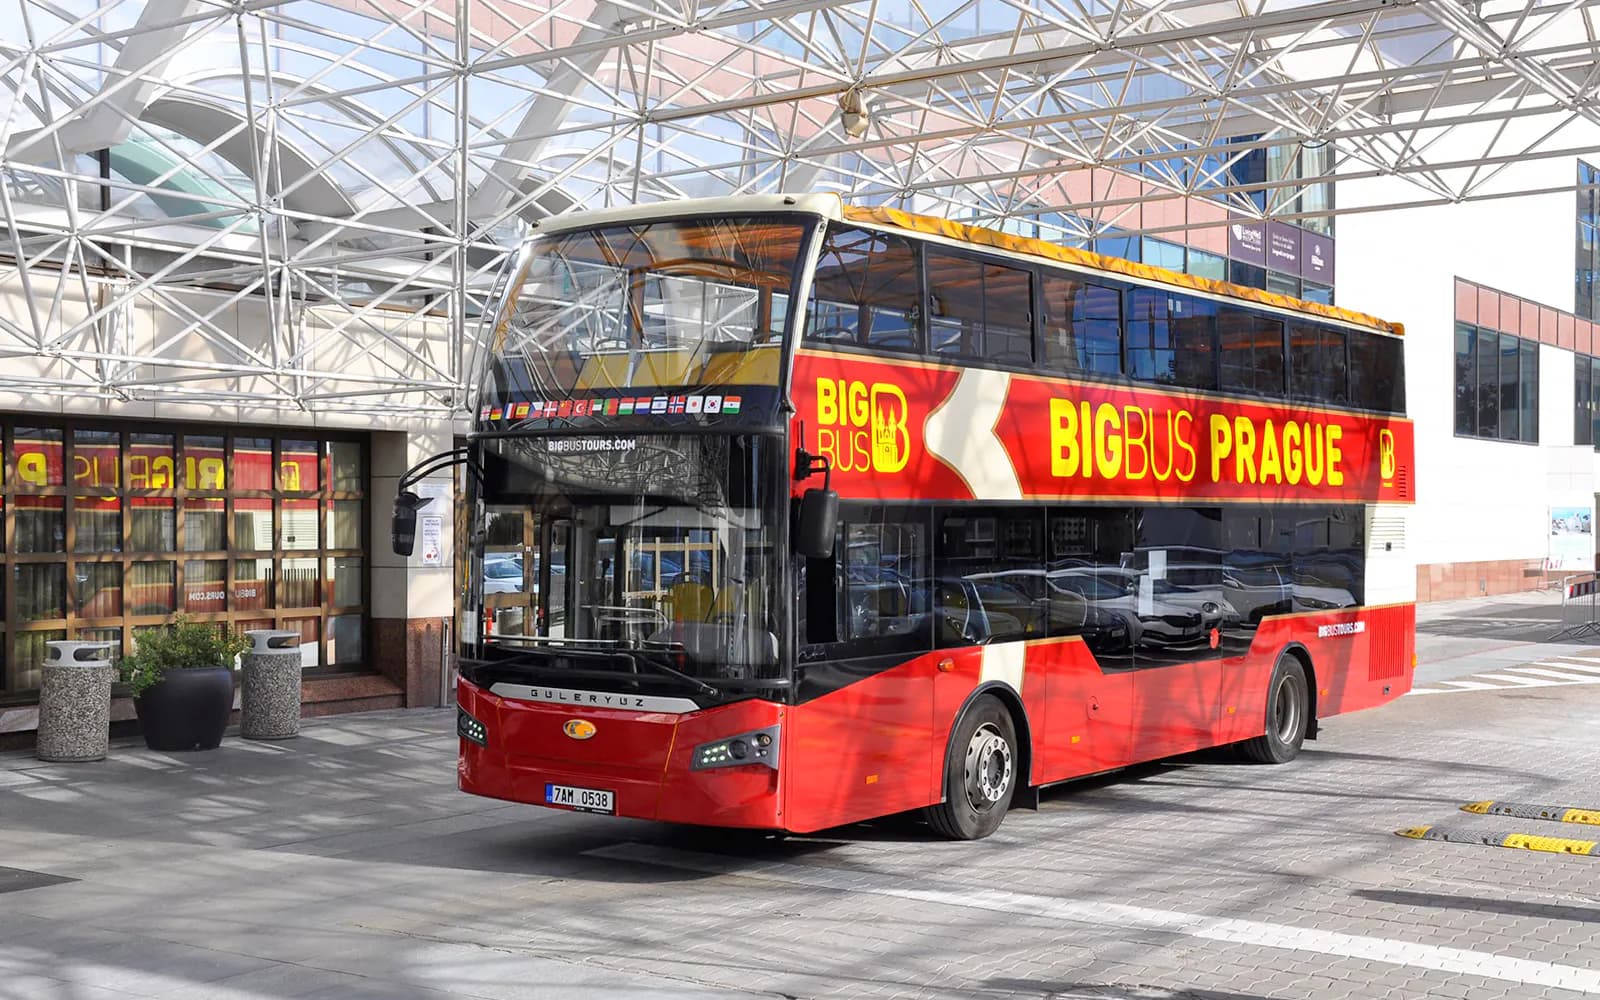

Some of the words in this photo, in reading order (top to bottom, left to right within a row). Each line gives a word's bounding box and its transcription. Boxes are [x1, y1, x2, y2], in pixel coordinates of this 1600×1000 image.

[816, 377, 869, 427] BIG
[548, 439, 636, 452] BIGBUSTOURS.COM
[817, 429, 871, 473] BUS
[1050, 398, 1196, 482] BIGBUS
[1210, 414, 1344, 486] PRAGUE
[554, 787, 574, 803] 7AM
[581, 790, 608, 807] 0538
